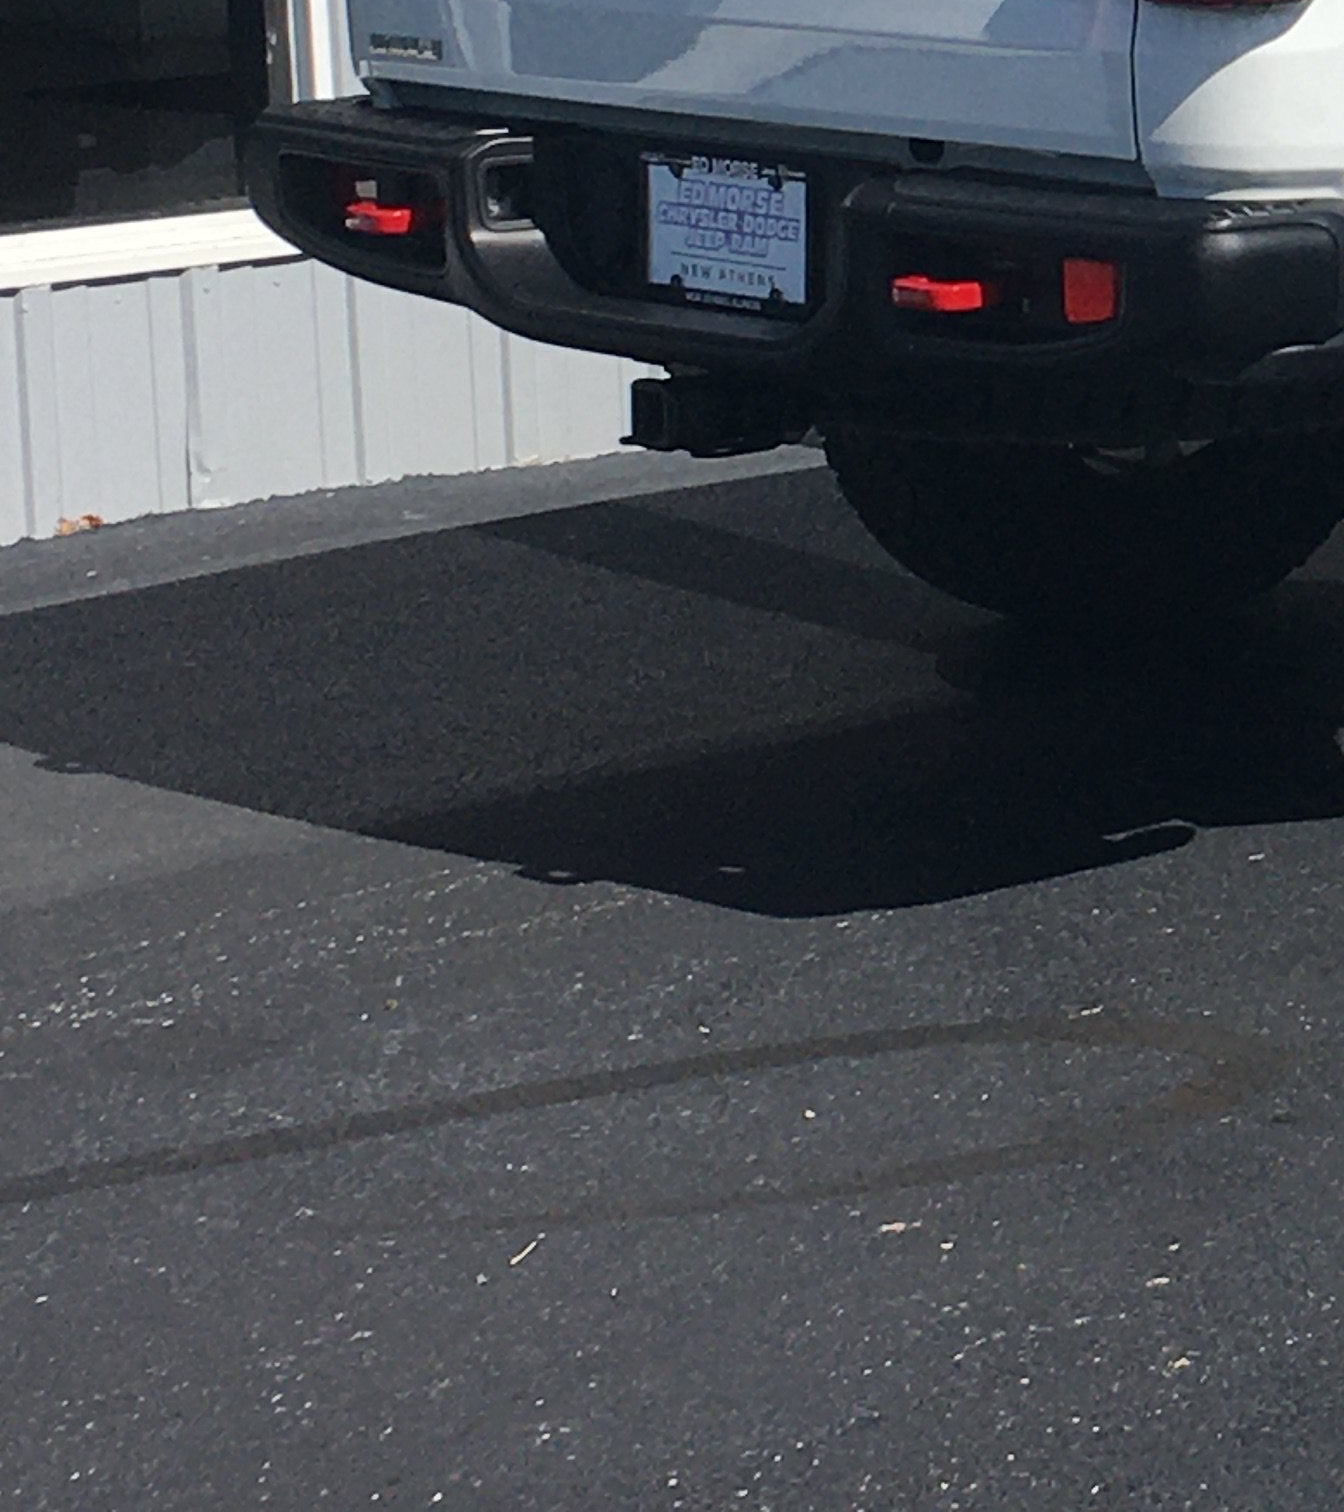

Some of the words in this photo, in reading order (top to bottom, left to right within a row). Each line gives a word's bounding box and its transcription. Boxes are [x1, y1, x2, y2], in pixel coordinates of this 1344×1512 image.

[679, 182, 705, 205] ED
[705, 184, 784, 216] MORSE
[681, 262, 712, 279] NEW
[718, 267, 776, 288] ATHENS
